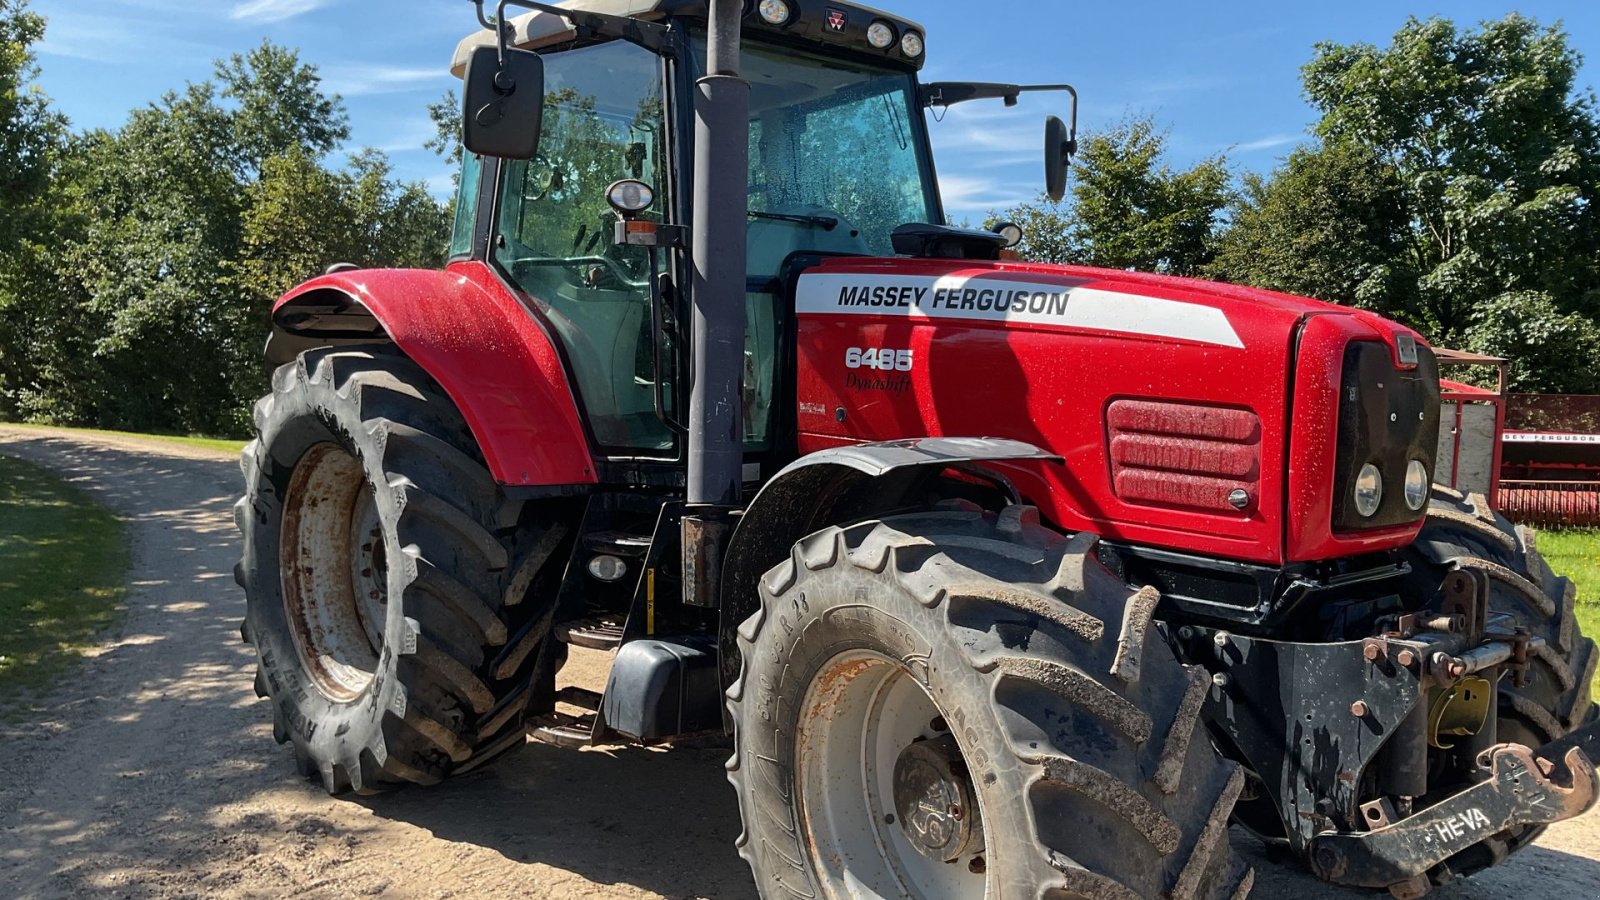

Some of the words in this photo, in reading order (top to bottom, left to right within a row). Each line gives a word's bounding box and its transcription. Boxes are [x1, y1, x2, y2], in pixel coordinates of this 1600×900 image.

[838, 286, 928, 307] MASSEY
[932, 288, 1071, 316] FERGUSON
[845, 347, 914, 372] 6485
[845, 372, 912, 397] Dynashift
